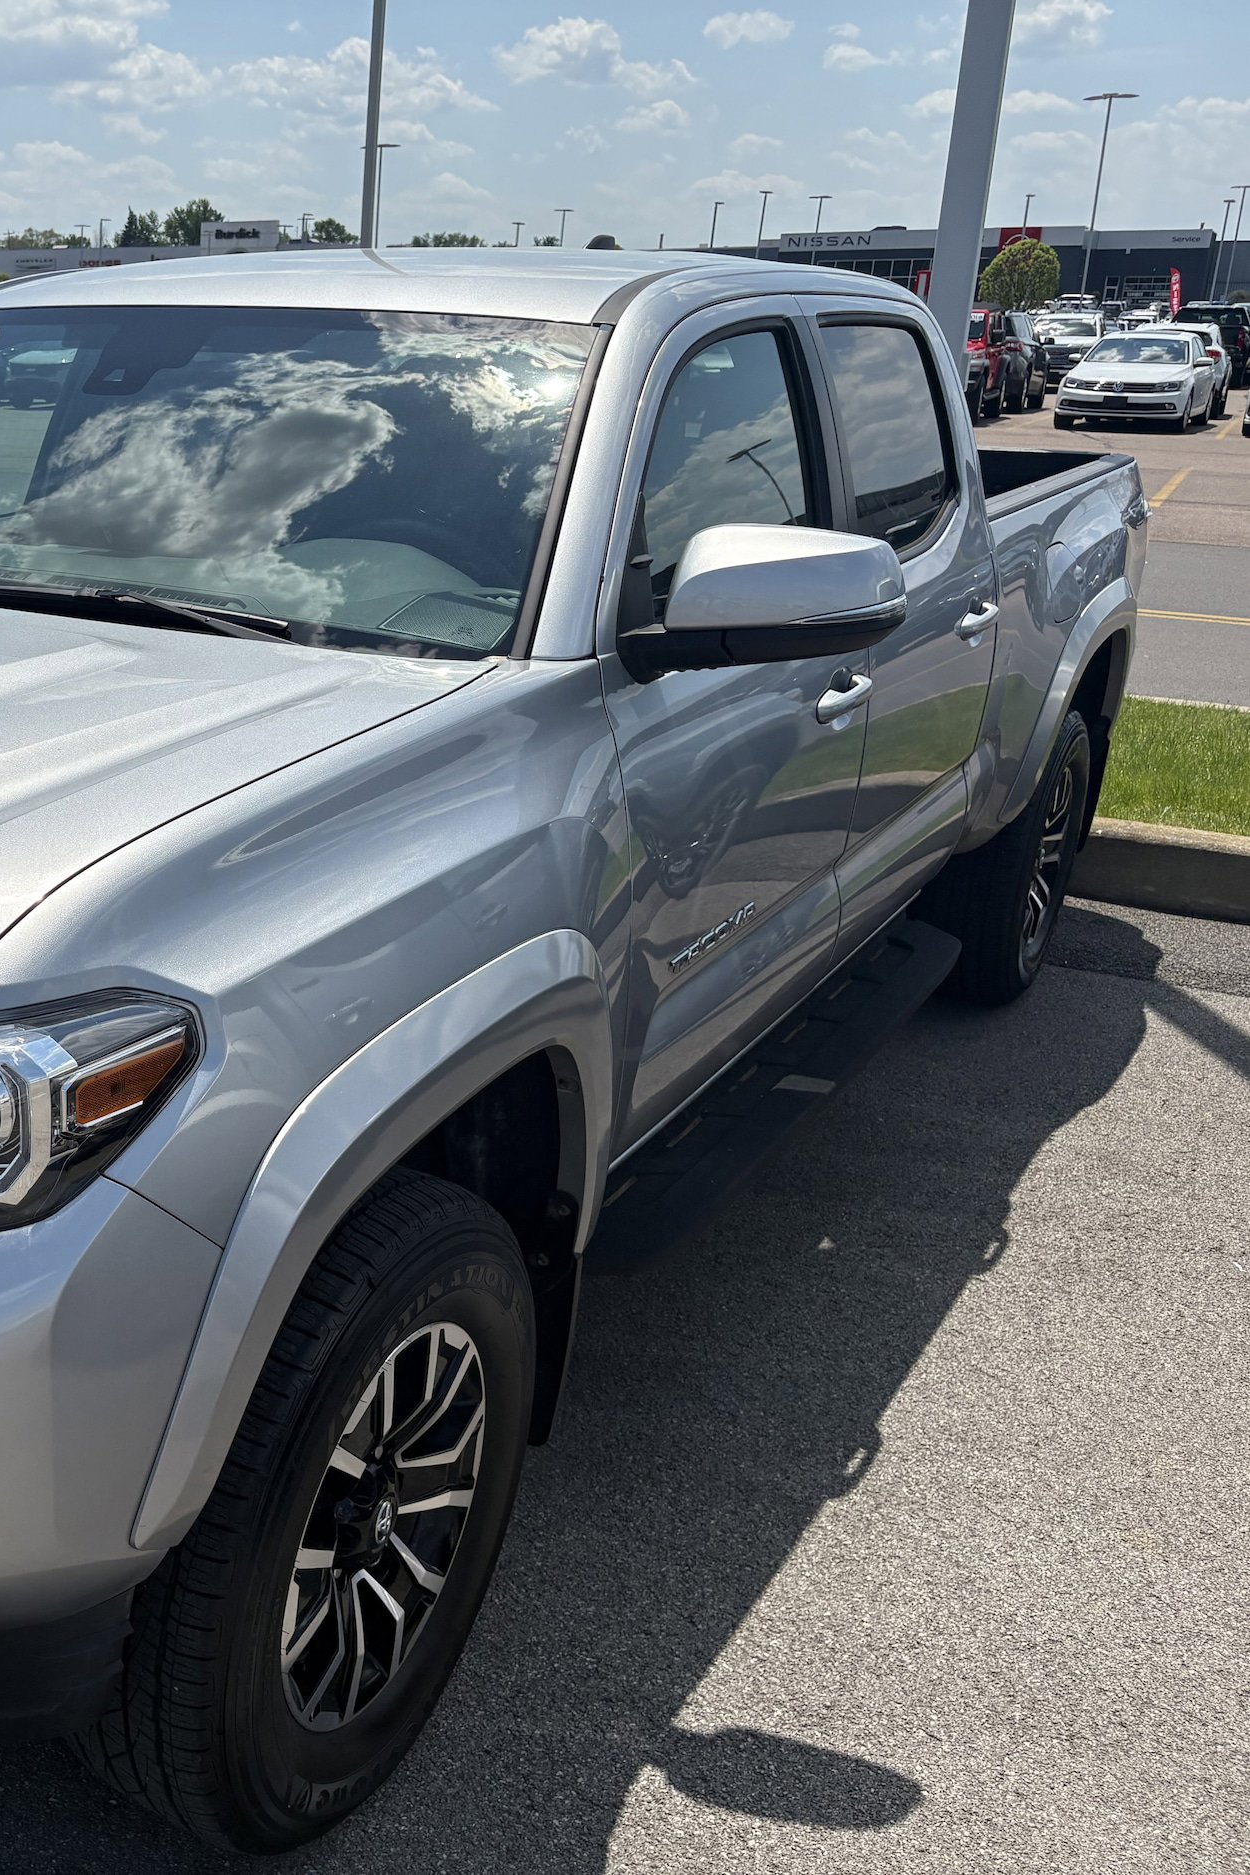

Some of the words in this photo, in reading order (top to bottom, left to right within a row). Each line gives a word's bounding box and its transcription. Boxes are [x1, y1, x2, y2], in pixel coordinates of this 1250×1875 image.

[215, 228, 261, 239] Burdick
[788, 235, 871, 248] NISSAN
[668, 902, 757, 973] TACOMA
